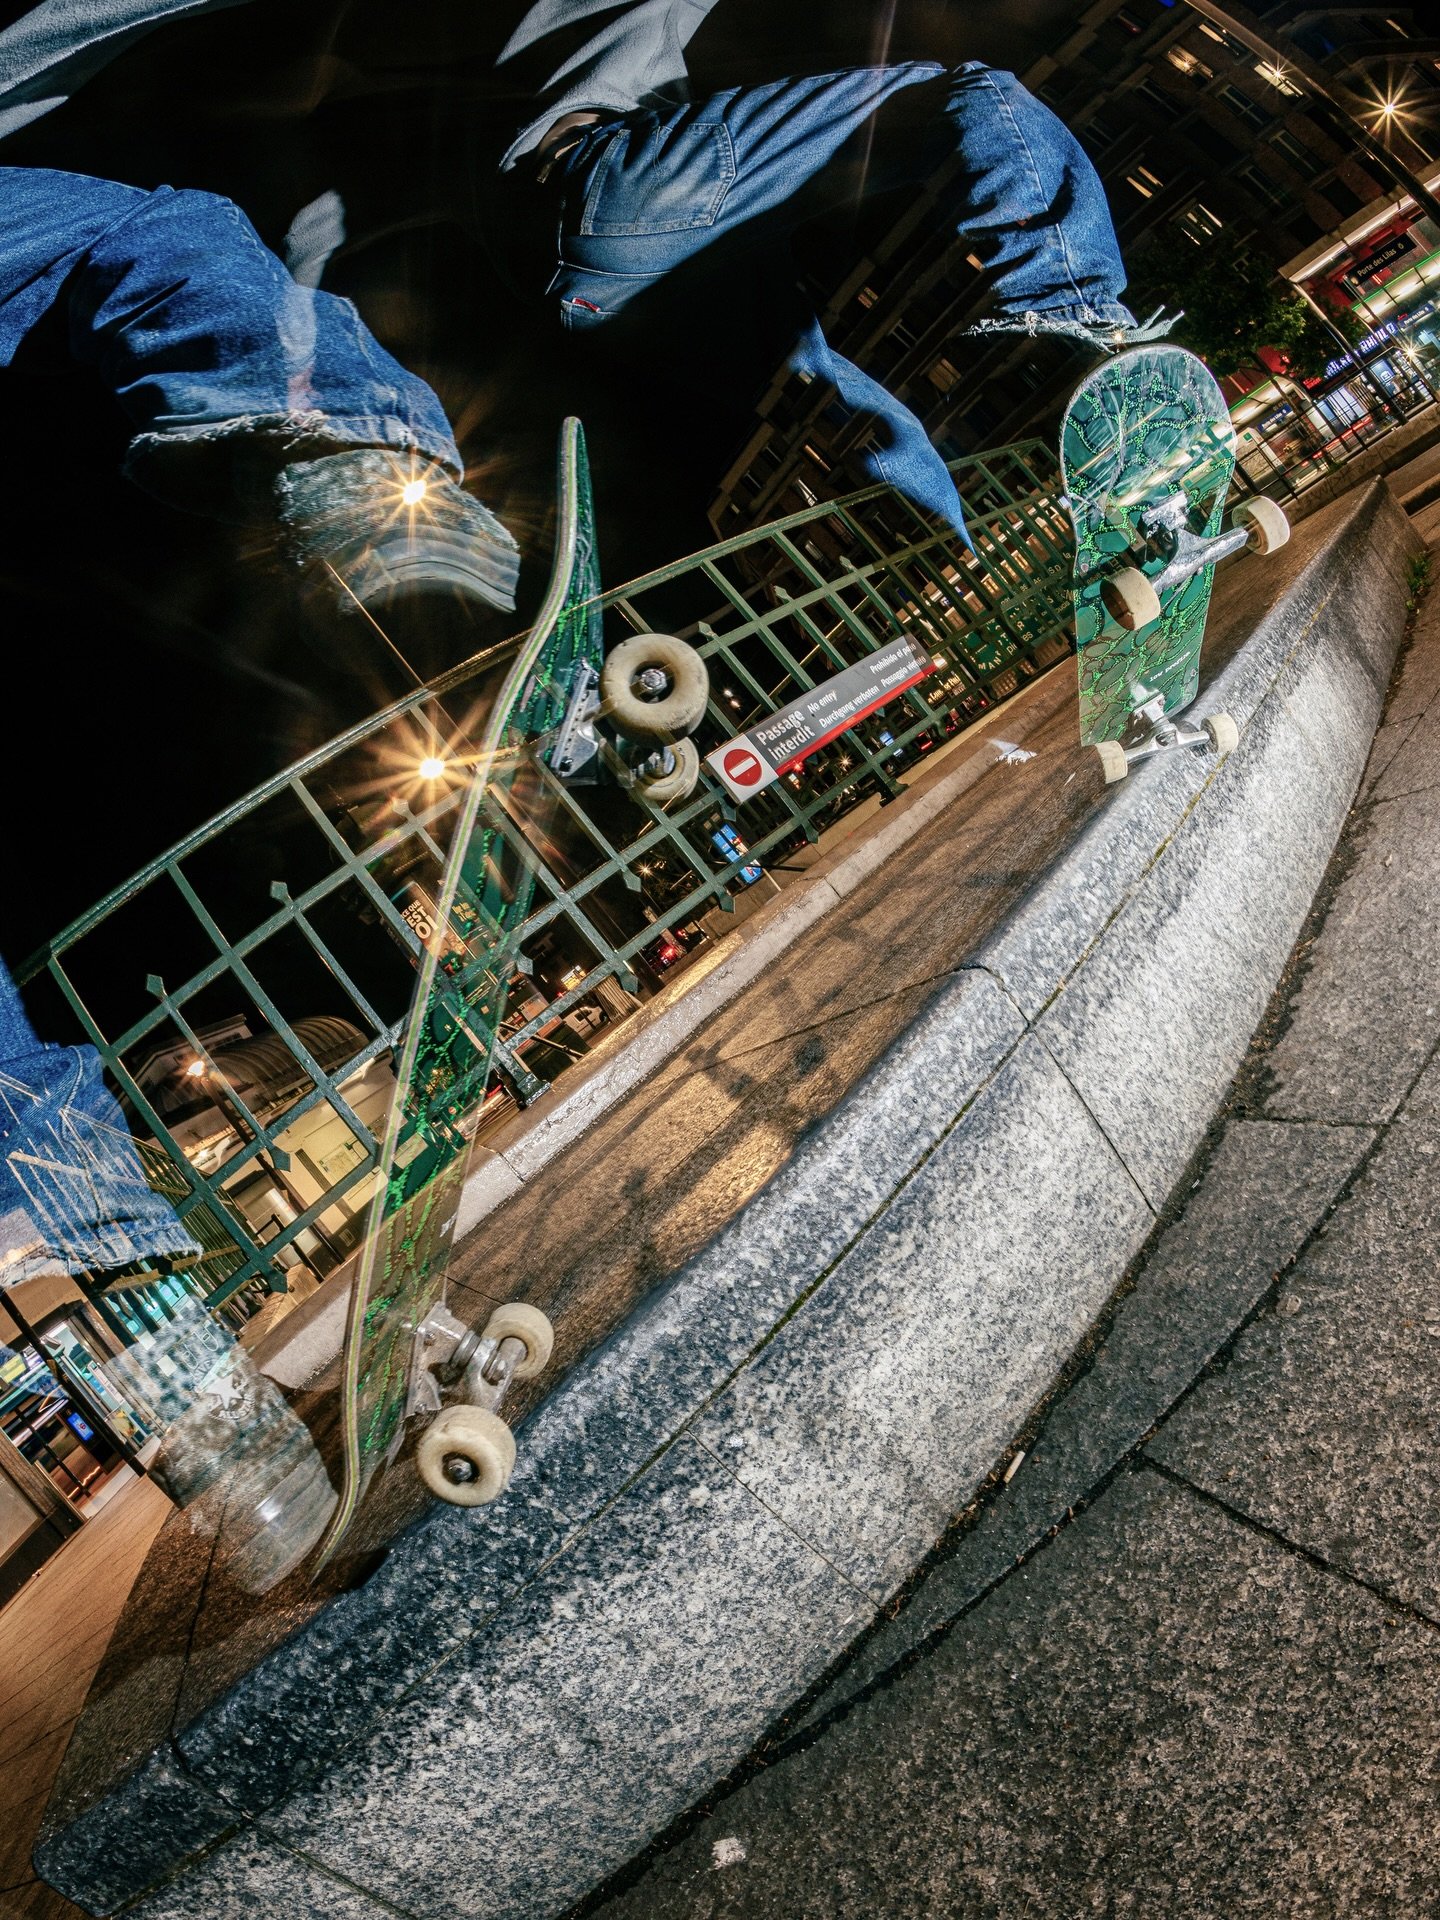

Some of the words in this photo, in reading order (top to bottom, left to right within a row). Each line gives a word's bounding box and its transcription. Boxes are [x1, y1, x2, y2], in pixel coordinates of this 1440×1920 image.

[1357, 262, 1374, 277] Porte
[1373, 258, 1384, 267] des
[1382, 248, 1397, 260] Lilas
[869, 653, 898, 675] Prohibido
[896, 647, 905, 659] el
[901, 642, 917, 658] paso
[880, 665, 909, 688] Passaggio
[907, 655, 927, 673] vietato
[807, 701, 819, 714] No
[818, 689, 838, 709] entry
[818, 699, 855, 729] Durchgang
[851, 684, 880, 709] verboten
[756, 709, 806, 745] Passage
[768, 724, 816, 761] interdit
[406, 905, 427, 929] EST
[407, 899, 422, 913] QUE
[411, 914, 440, 940] OI
